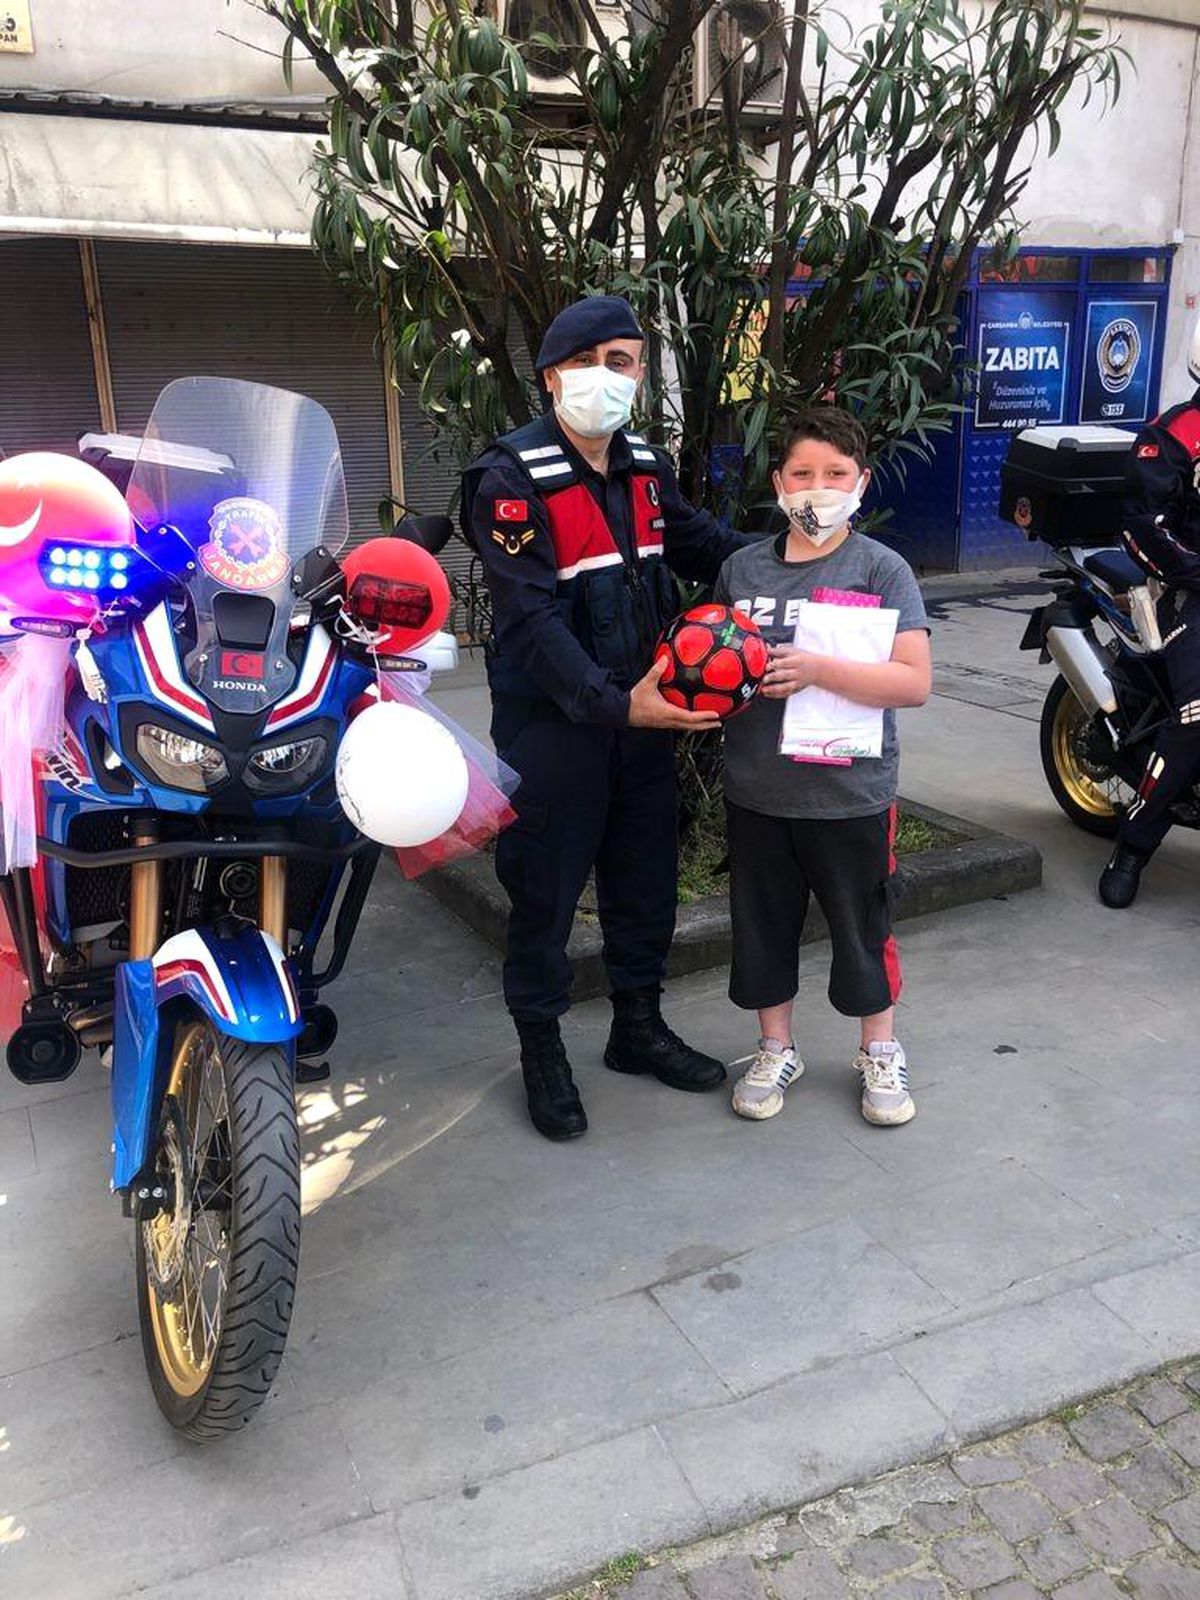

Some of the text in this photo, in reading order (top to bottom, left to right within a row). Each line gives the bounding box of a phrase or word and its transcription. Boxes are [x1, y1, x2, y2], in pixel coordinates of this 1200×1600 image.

[985, 346, 1060, 372] ZABITA
[1002, 419, 1016, 428] 444
[212, 680, 267, 693] HONDA
